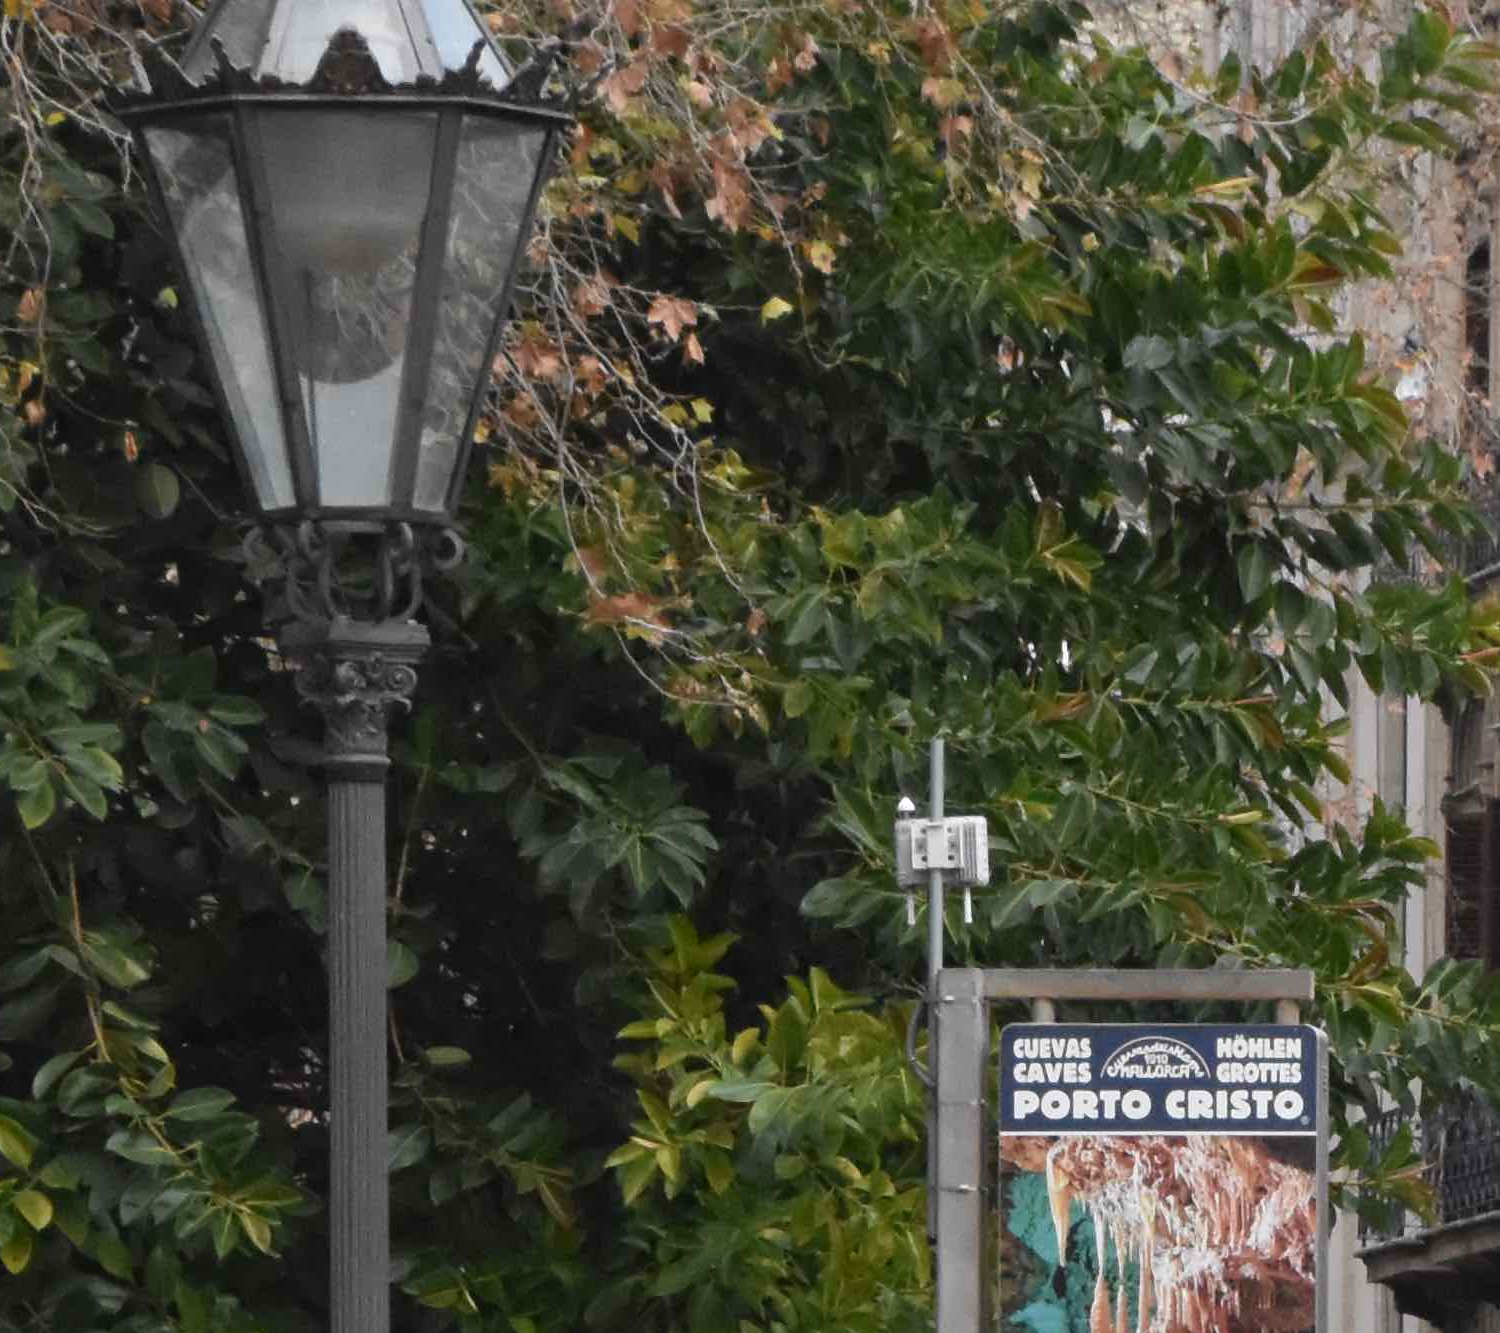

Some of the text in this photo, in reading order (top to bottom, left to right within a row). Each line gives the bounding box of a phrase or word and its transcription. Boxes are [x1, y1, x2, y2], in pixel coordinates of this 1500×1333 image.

[1013, 1038, 1092, 1058] CUEVAS
[1217, 1034, 1301, 1058] HÖHLEN
[1013, 1062, 1092, 1083] CAVES
[1120, 1064, 1190, 1078] MALLORCA
[1217, 1062, 1301, 1083] GROTTES
[1013, 1089, 1304, 1120] PORTO CRISTO
